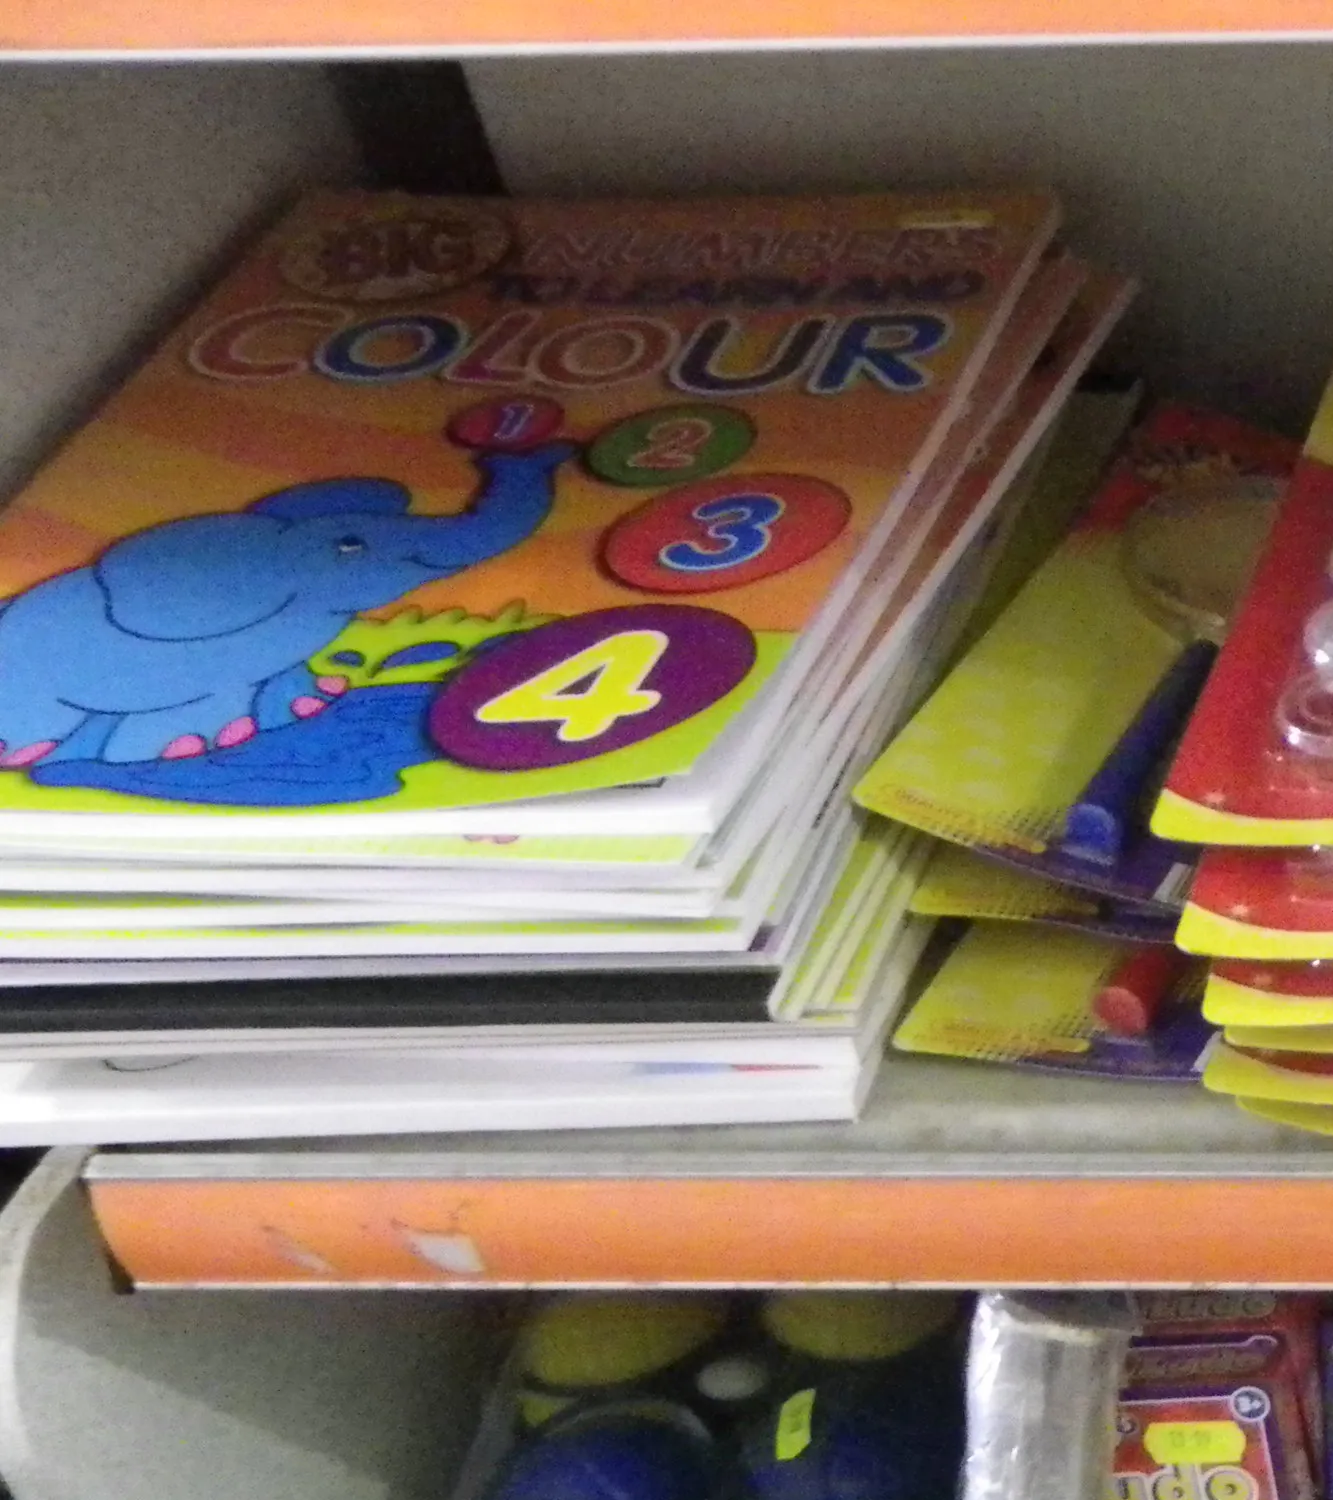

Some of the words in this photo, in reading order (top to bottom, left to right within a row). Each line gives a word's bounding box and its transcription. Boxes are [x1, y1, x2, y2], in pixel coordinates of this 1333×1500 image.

[189, 304, 956, 394] COLOUR
[496, 404, 537, 440] 1
[626, 415, 716, 470] 2
[657, 491, 788, 573] 3
[473, 628, 670, 744] 4
